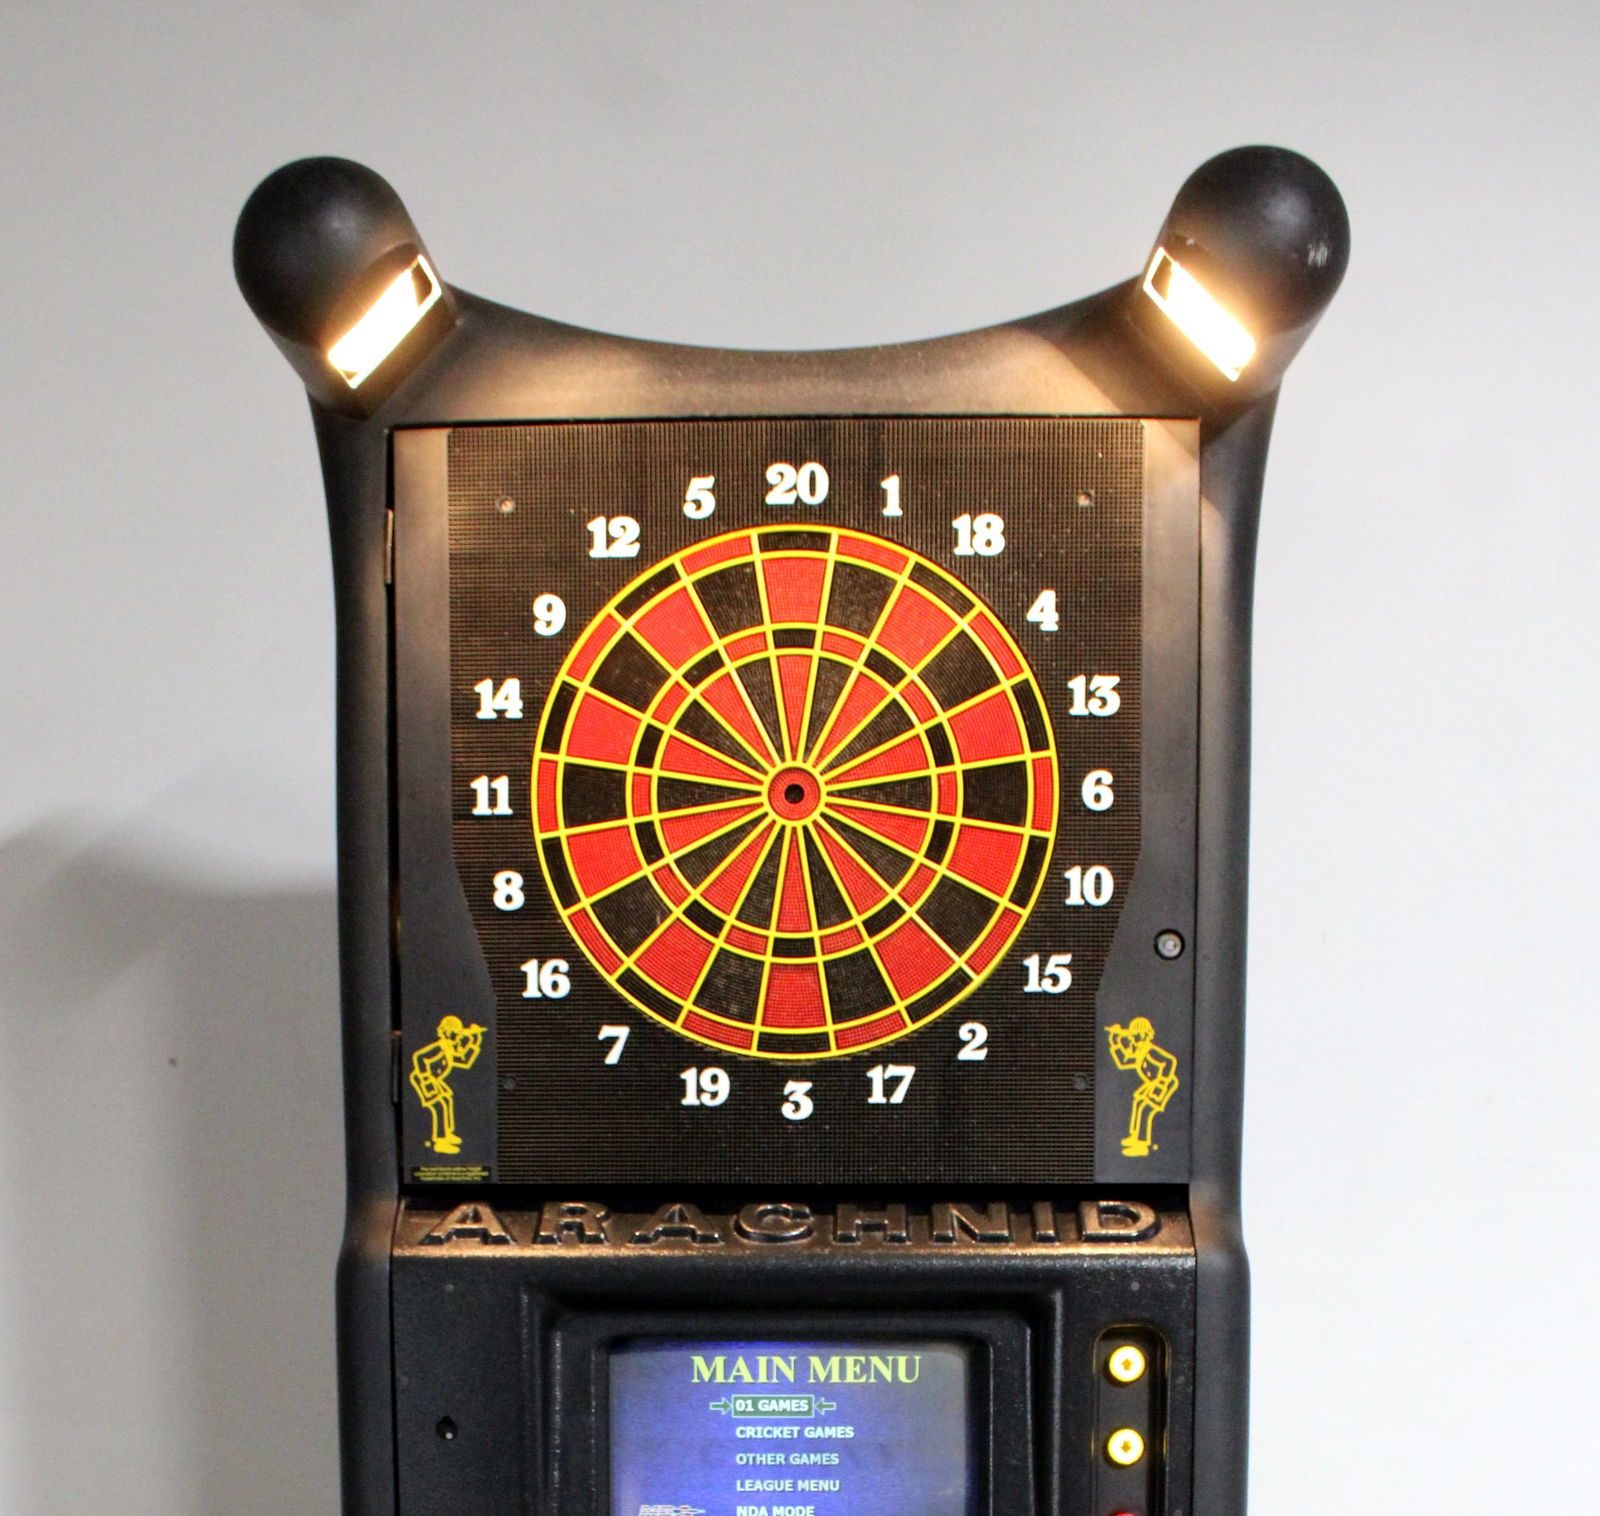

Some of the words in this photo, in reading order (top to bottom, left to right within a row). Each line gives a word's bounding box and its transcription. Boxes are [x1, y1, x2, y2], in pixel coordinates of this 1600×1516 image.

[682, 475, 716, 520] 5
[765, 462, 830, 505] 20
[880, 474, 903, 517] 1
[586, 516, 641, 559] 12
[951, 513, 1006, 557] 18
[532, 593, 567, 637] 9
[1026, 589, 1060, 632] 4
[474, 678, 524, 720] 14
[1067, 674, 1121, 717] 13
[470, 775, 514, 816] 11
[1081, 769, 1115, 811] 6
[492, 870, 526, 911] 8
[1063, 865, 1114, 906] 10
[520, 959, 571, 999] 16
[1022, 953, 1073, 994] 15
[598, 1025, 631, 1065] 7
[957, 1022, 989, 1061] 2
[680, 1067, 731, 1107] 19
[781, 1080, 814, 1121] 3
[866, 1064, 916, 1104] 17
[419, 1200, 1162, 1246] ARACHNID
[691, 1355, 797, 1384] MAIN
[807, 1355, 922, 1384] MENU
[735, 1399, 754, 1412] 01
[758, 1399, 809, 1412] GAMES
[735, 1426, 800, 1439] CRICKET
[804, 1426, 855, 1439] GAMES
[735, 1453, 785, 1466] OTHER
[789, 1453, 840, 1466] GAMES
[736, 1480, 793, 1493] LEAGUE
[797, 1480, 840, 1493] MENU
